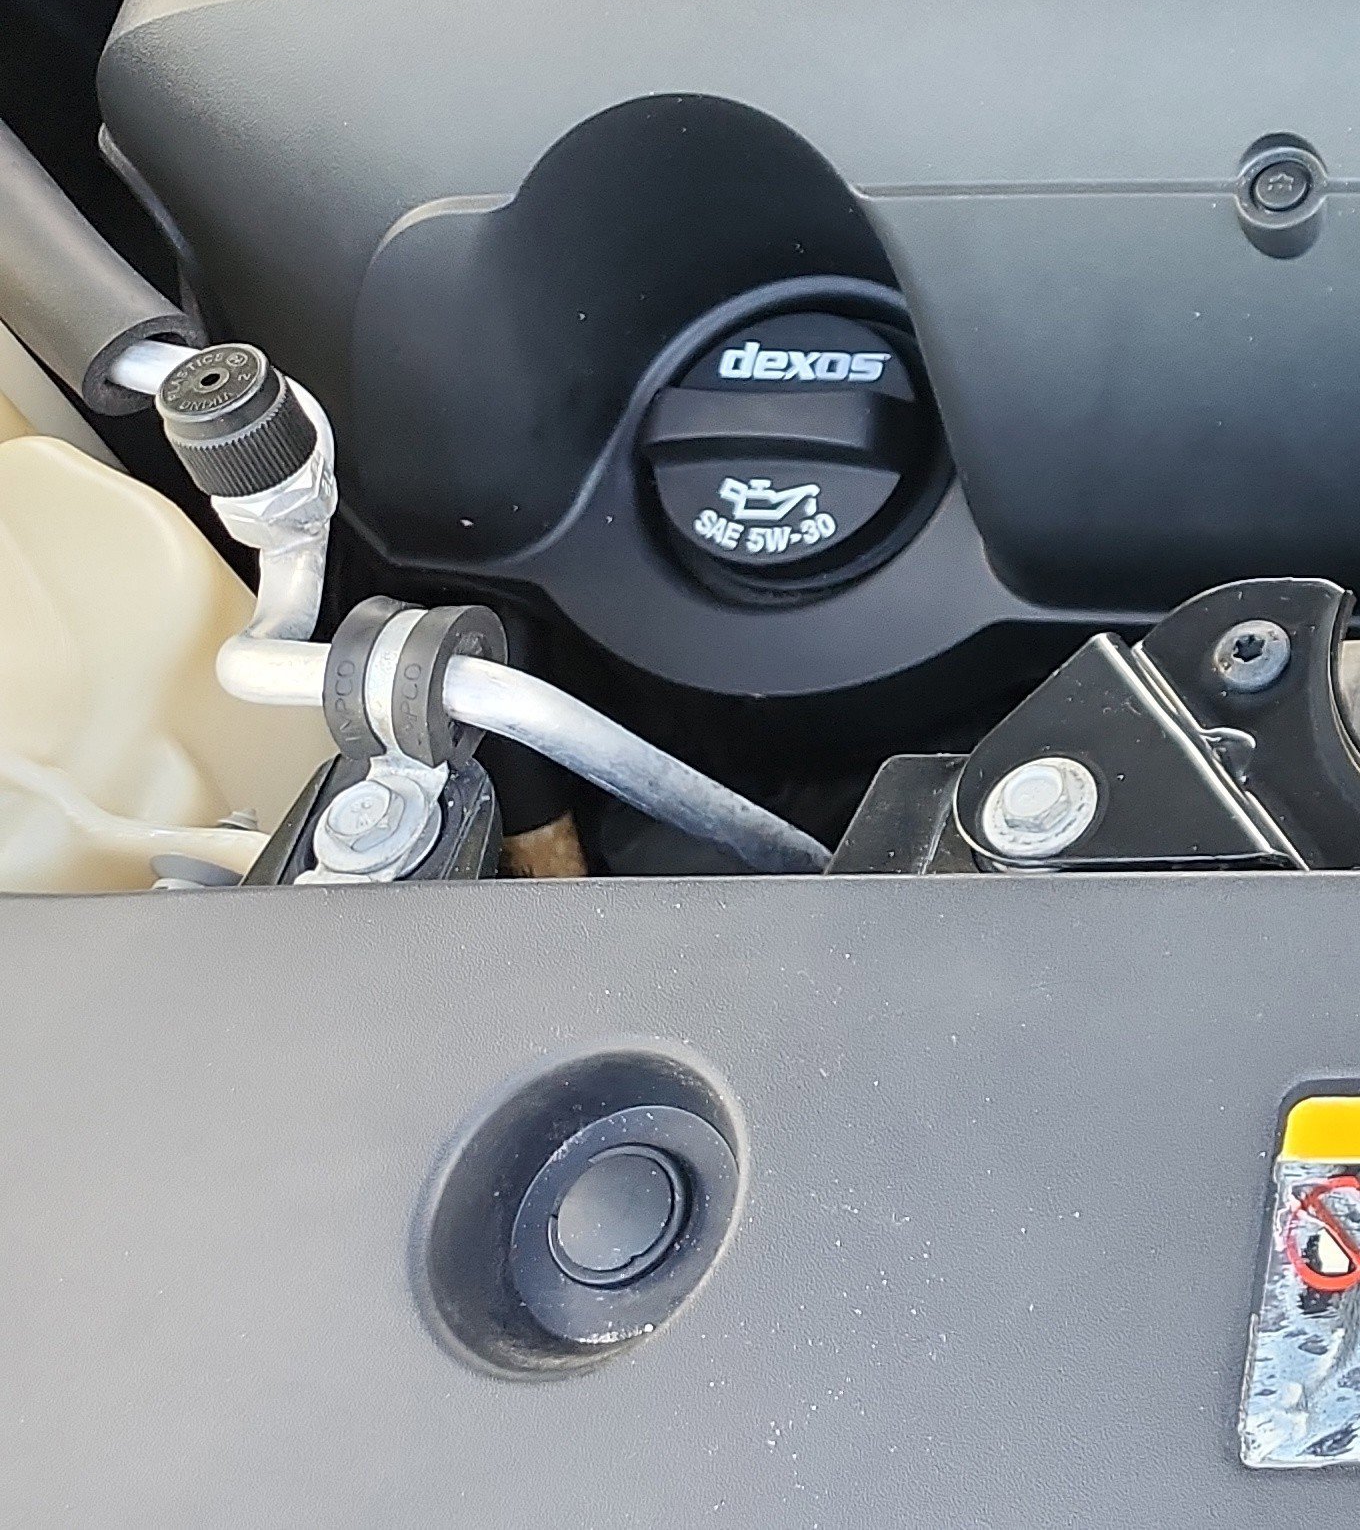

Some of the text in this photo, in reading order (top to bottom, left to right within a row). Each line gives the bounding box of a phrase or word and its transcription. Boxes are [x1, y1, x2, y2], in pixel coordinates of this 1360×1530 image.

[719, 341, 891, 381] dexos
[693, 509, 836, 553] SAE 5W-30
